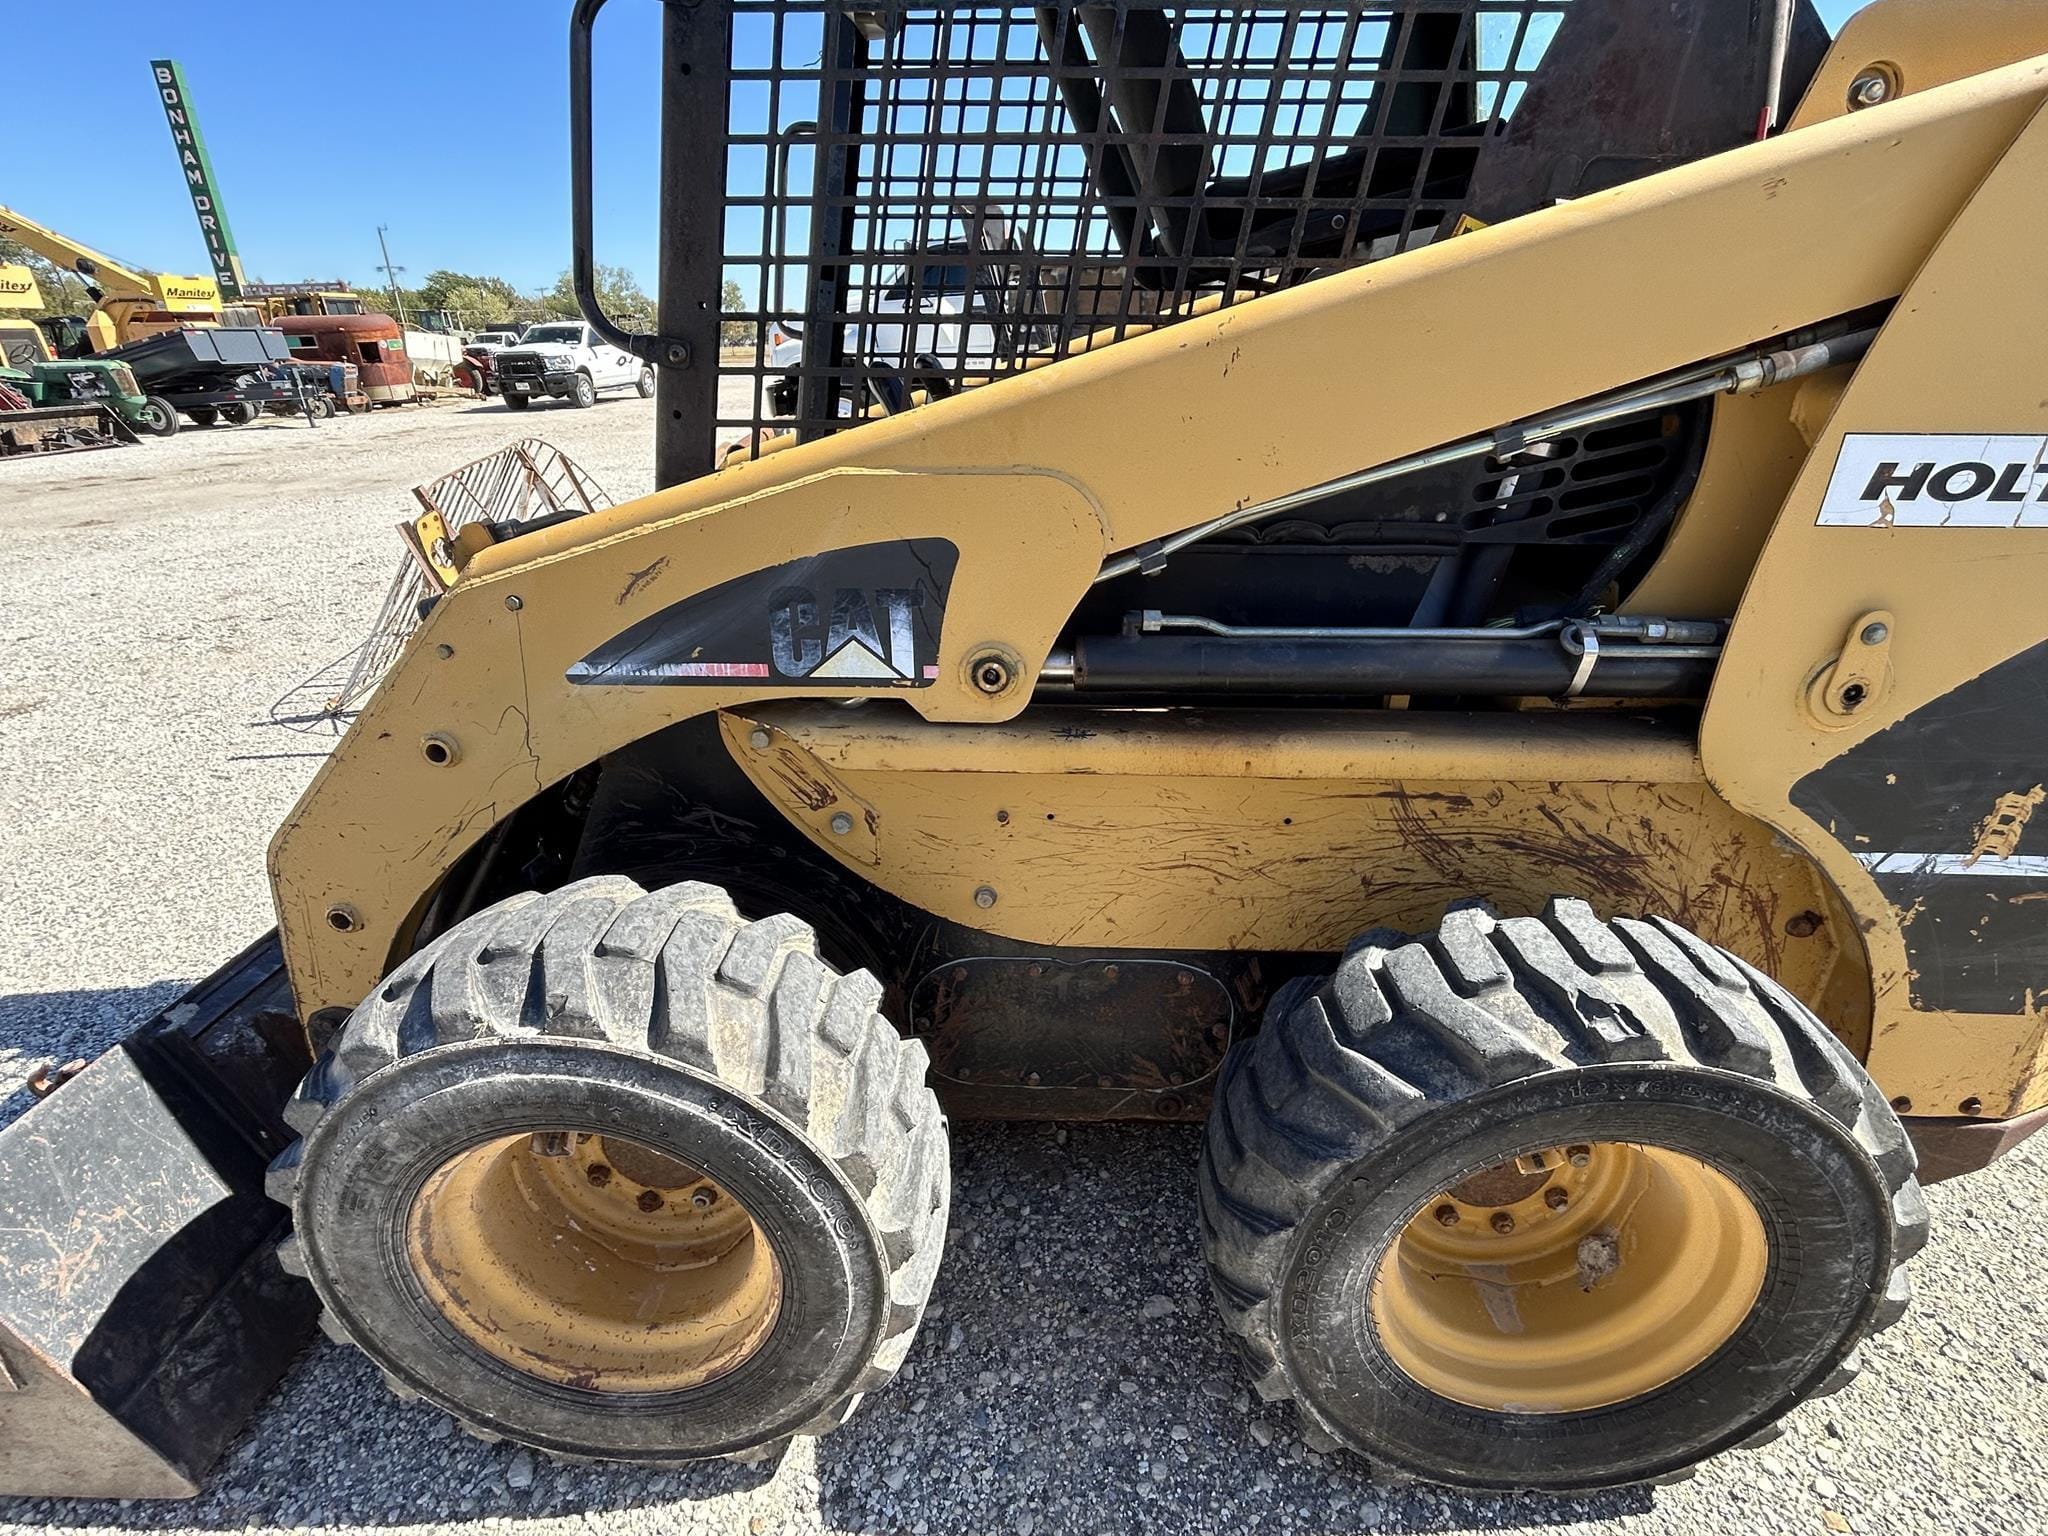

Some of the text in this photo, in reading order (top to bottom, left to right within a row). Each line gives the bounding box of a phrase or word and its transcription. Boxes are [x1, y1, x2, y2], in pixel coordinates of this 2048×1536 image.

[155, 67, 234, 286] BONHAM DRIVE
[166, 287, 216, 299] Manitex
[767, 587, 925, 679] CAT
